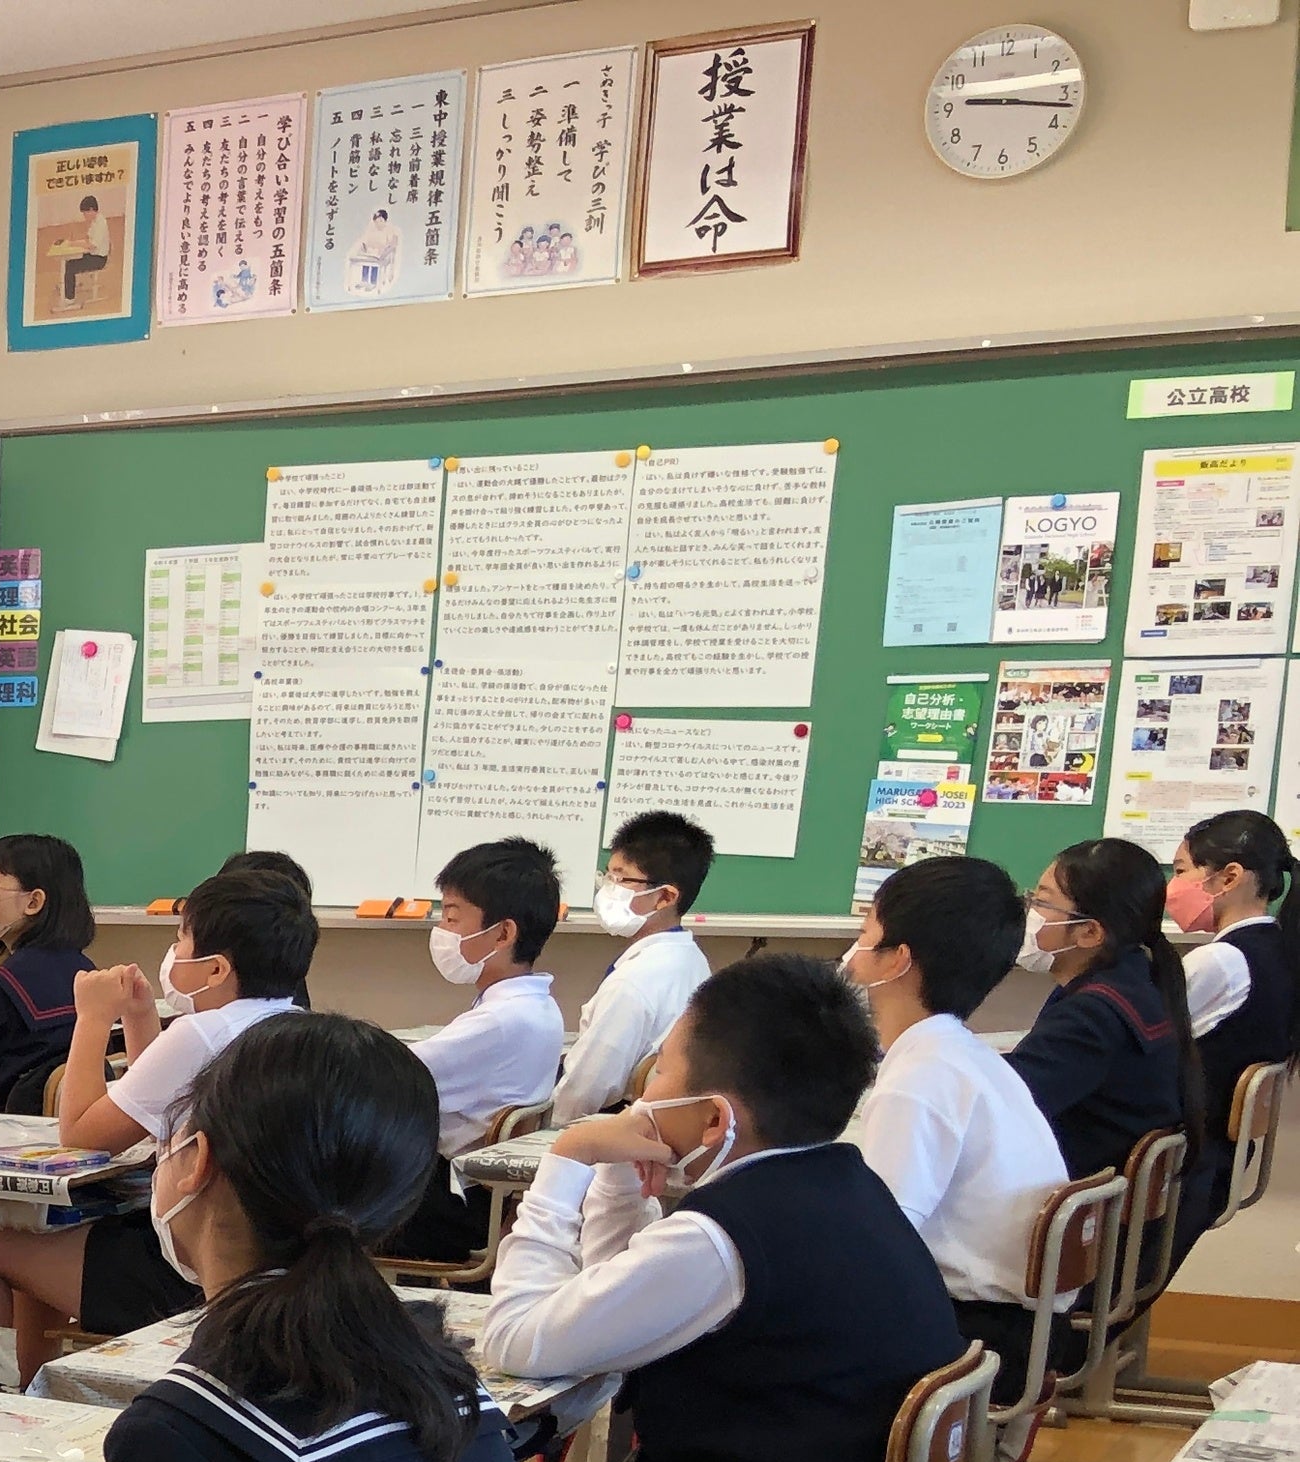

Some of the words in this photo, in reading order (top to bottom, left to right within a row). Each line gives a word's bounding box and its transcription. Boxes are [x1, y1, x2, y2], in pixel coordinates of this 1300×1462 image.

[972, 49, 985, 67] 11
[1001, 39, 1015, 56] 12
[1034, 43, 1038, 58] 1
[1051, 59, 1060, 76] 2
[596, 64, 614, 129] さぬきっ子
[943, 102, 953, 118] 9
[951, 74, 965, 90] 10
[1058, 85, 1069, 101] 3
[524, 107, 548, 197] 姿勢整え
[556, 103, 580, 182] 準備して
[685, 46, 757, 255] 授業は命
[950, 127, 961, 144] 8
[1026, 136, 1038, 153] 5
[1048, 114, 1059, 129] 4
[46, 169, 125, 190] できていますか？
[56, 155, 109, 174] 正しい姿勢
[348, 132, 363, 195] 背筋ピン
[367, 130, 383, 192] 私語なし
[387, 128, 403, 205] 忘れ物なし
[405, 126, 423, 204] 三分前着席
[423, 89, 450, 266] 東中授業規律五箇条
[490, 112, 513, 243] しっかり聞こう
[972, 144, 982, 162] 7
[997, 148, 1008, 165] 6
[196, 140, 212, 272] 友だちの考えを認める
[215, 138, 231, 259] 友だちの考えを聞く
[233, 135, 249, 255] 自分の言葉で伝える
[252, 133, 267, 239] 自分の考えをもつ
[268, 115, 293, 297] 学び合い学習の五箇条
[324, 136, 341, 251] ノートを必ずとる
[584, 140, 612, 235] 学びの三訓
[176, 144, 196, 314] みんなでより良い意見に高める
[1166, 384, 1252, 408] 公立高校
[1025, 516, 1097, 533] KOGYO
